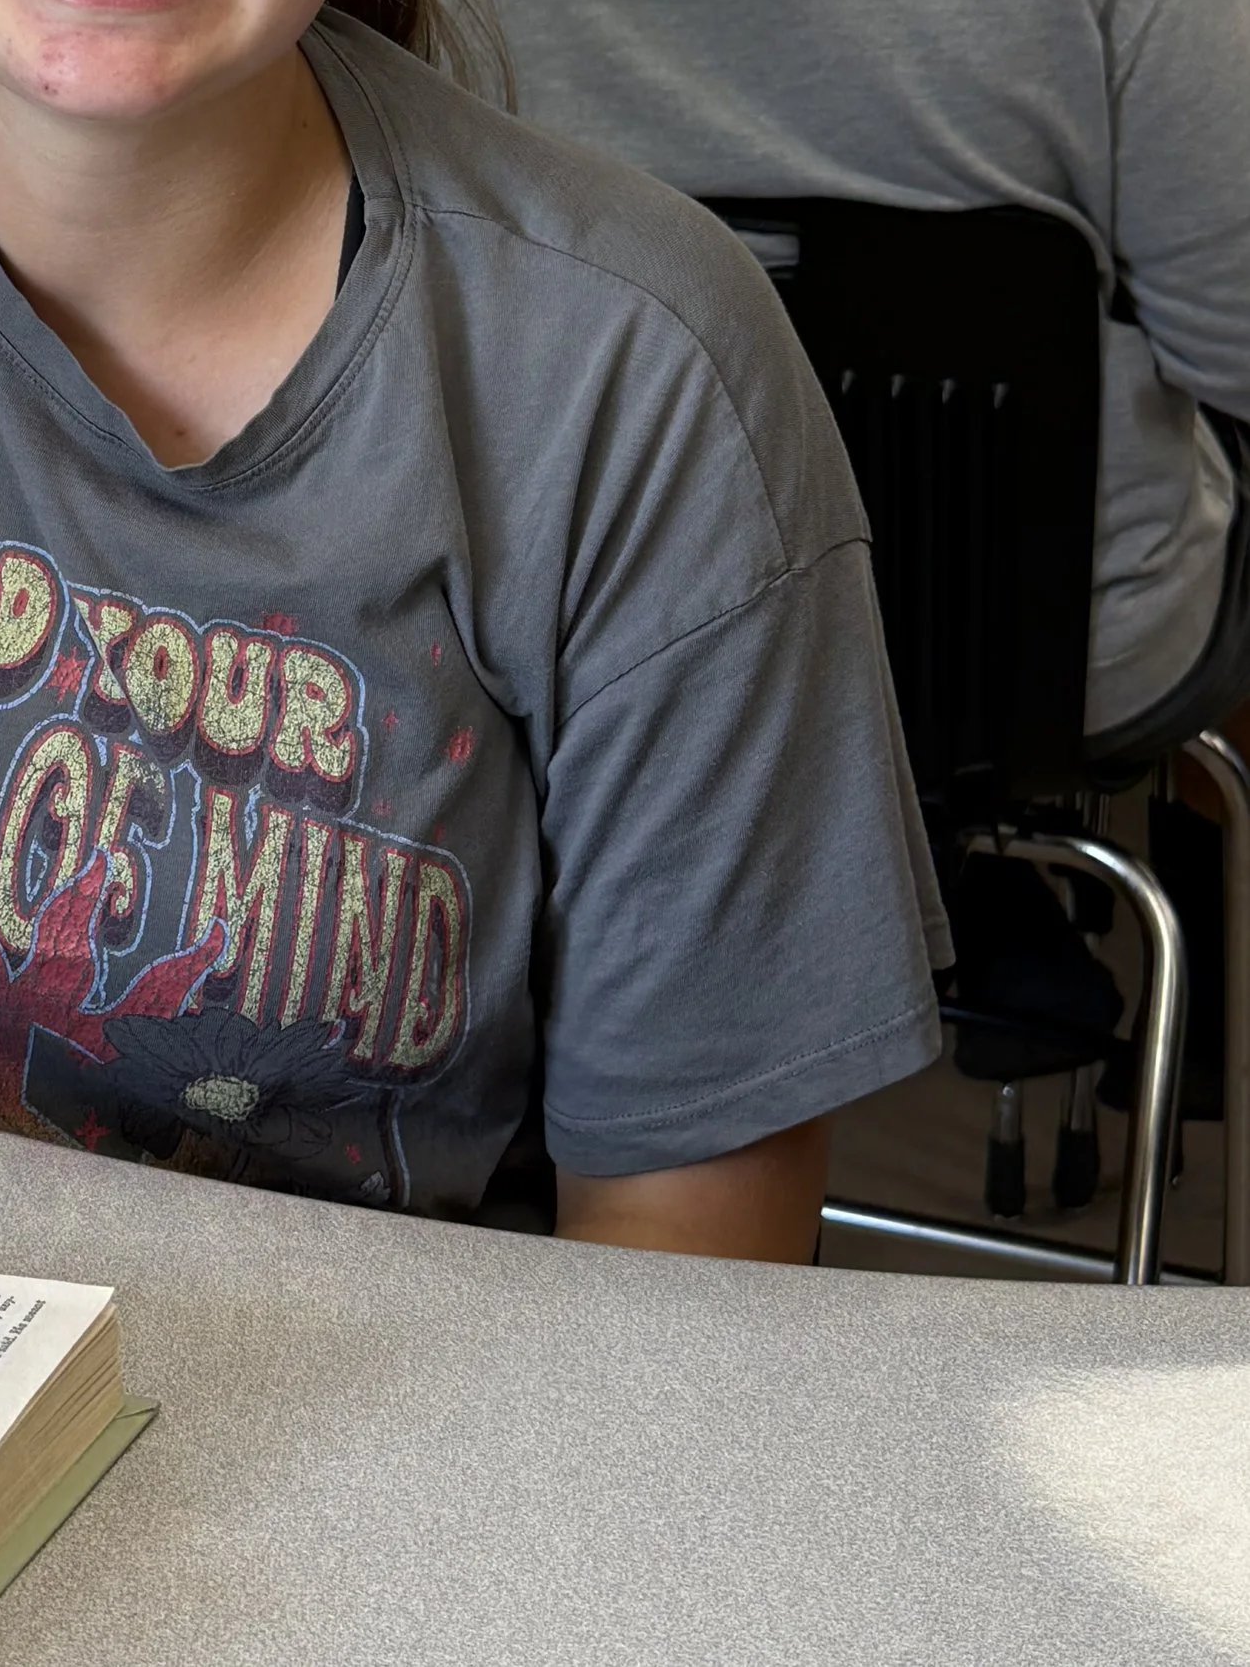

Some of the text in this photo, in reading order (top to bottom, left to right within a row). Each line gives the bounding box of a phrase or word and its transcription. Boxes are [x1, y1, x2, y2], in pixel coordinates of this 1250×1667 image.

[72, 591, 362, 796] YOUR
[1, 722, 162, 949] OF
[190, 790, 466, 1073] MIND
